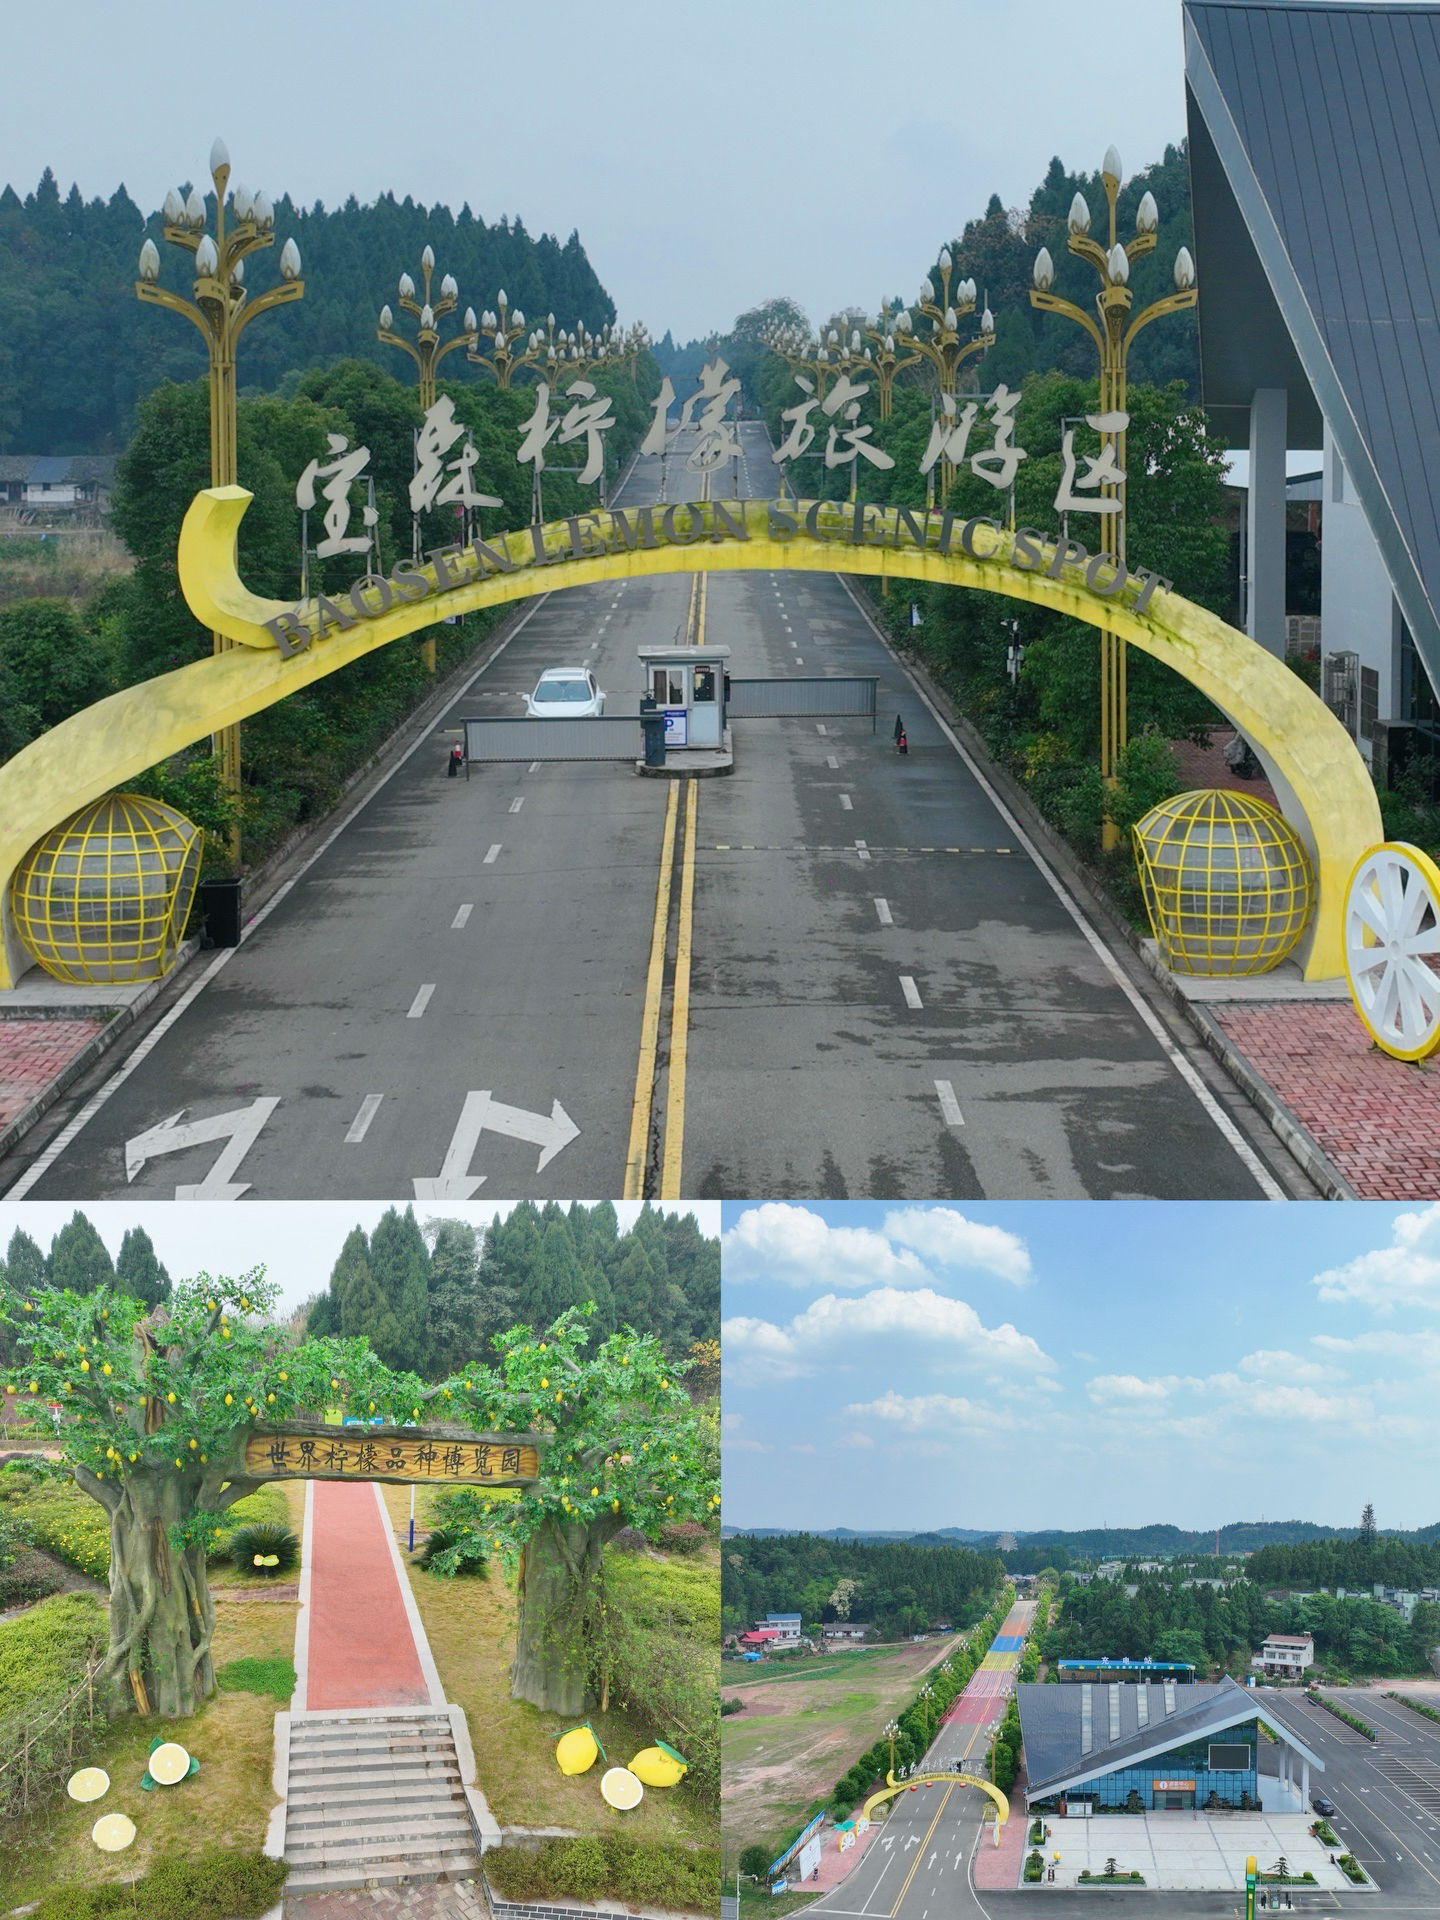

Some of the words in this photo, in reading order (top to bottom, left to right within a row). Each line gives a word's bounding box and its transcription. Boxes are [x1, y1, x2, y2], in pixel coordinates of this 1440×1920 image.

[264, 529, 520, 660] BAOSEN
[526, 500, 752, 567] LEMON
[766, 498, 1003, 559] SCENIC
[1011, 527, 1174, 613] SPOT
[265, 1440, 521, 1477] 世界柠檬品种博览园
[1101, 1656, 1153, 1665] 充电站
